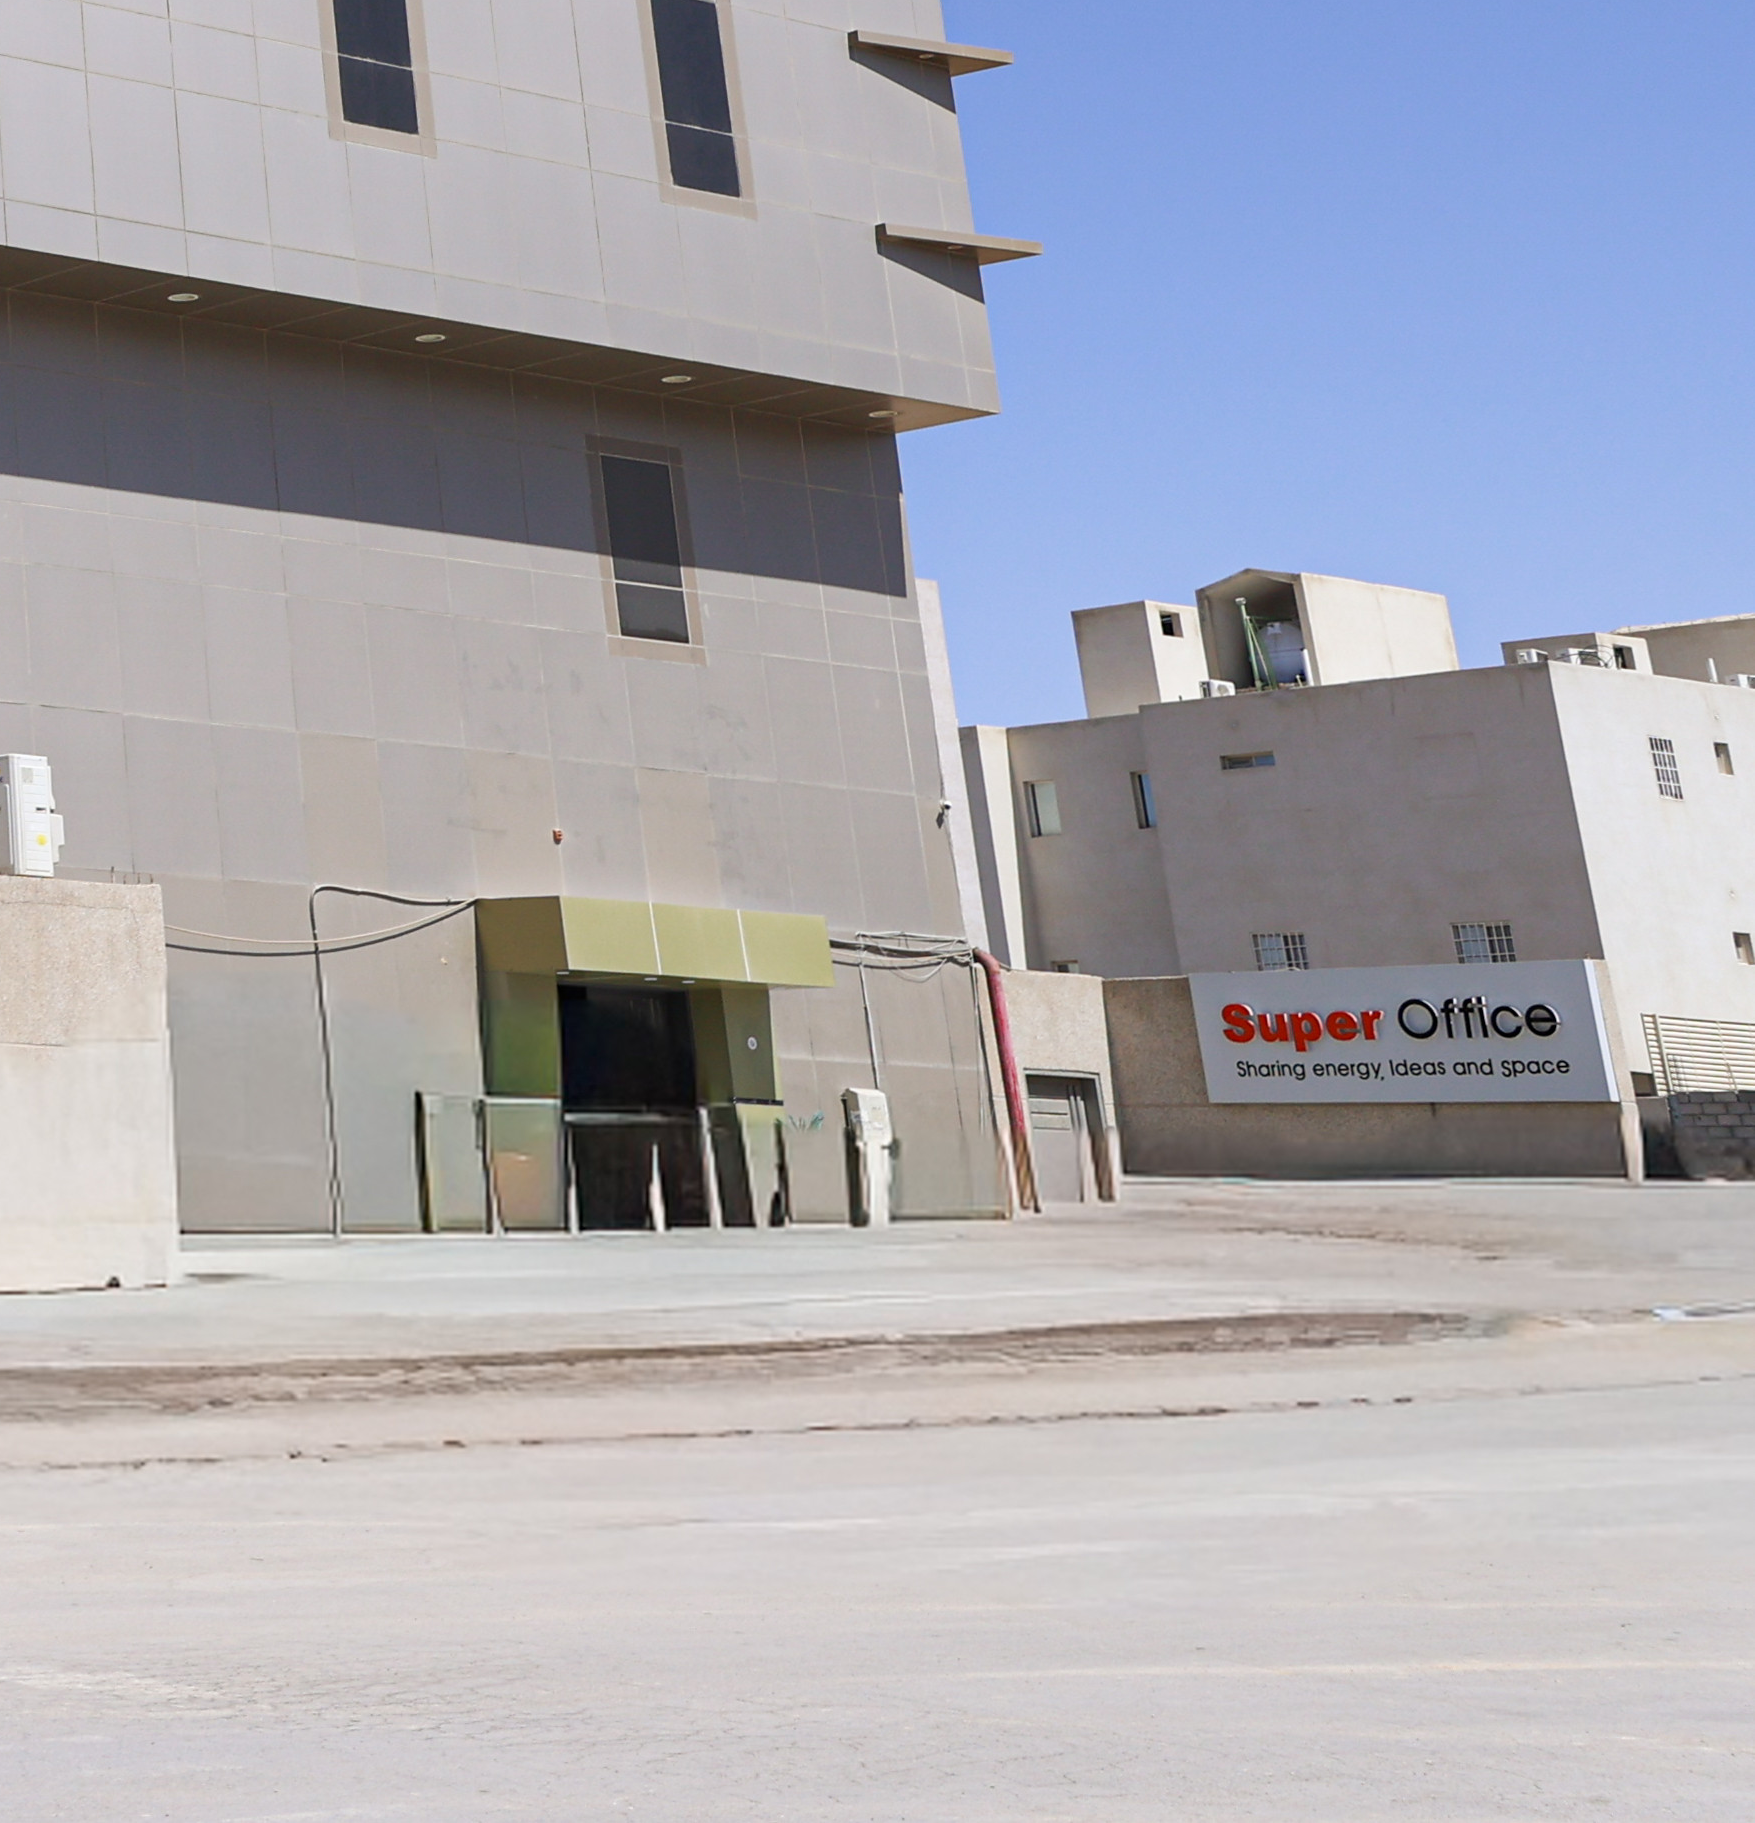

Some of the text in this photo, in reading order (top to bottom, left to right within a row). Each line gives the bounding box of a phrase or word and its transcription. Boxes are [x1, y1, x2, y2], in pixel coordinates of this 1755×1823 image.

[1221, 996, 1562, 1053] Super Office
[1236, 1060, 1306, 1081] Sharing
[1312, 1060, 1385, 1081] energy,
[1452, 1058, 1494, 1076] and
